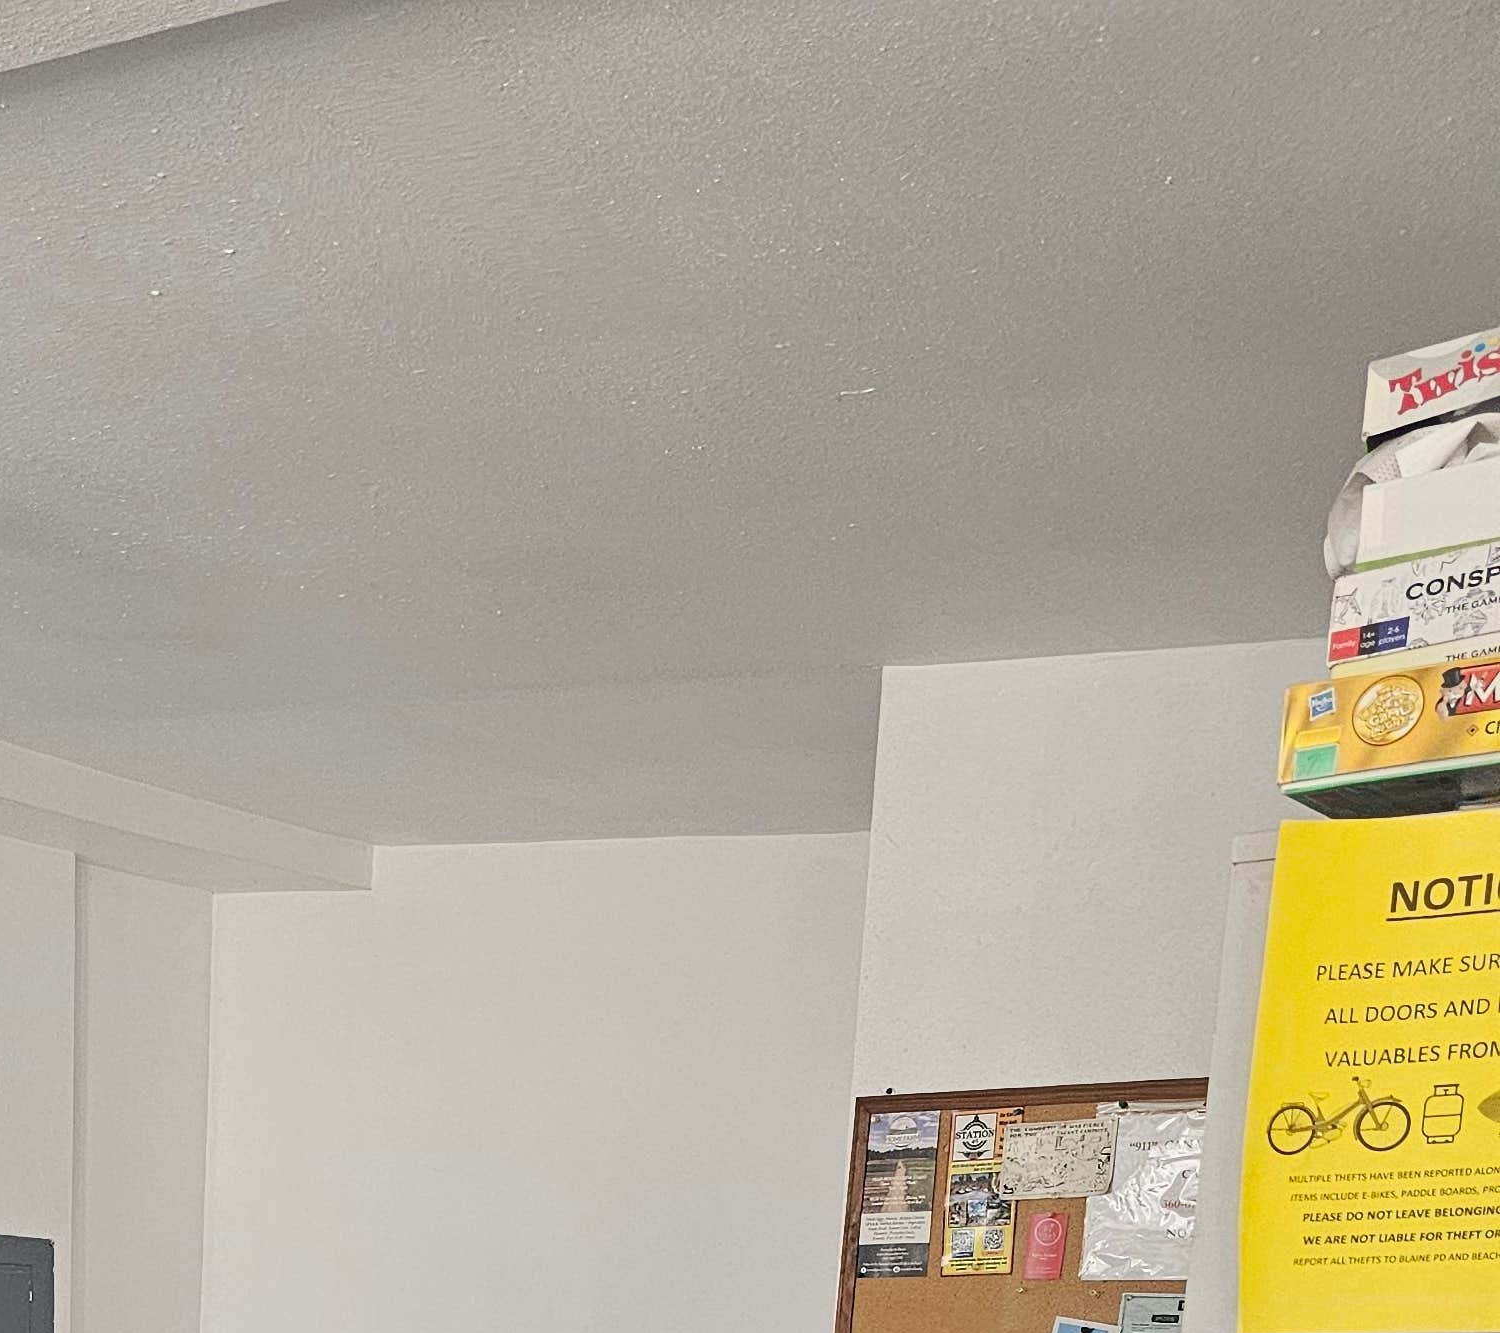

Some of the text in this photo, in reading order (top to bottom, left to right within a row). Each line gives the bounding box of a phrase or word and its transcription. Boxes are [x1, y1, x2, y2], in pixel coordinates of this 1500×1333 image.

[1405, 566, 1500, 600] CONSP
[1446, 596, 1500, 614] THE GAM
[1446, 645, 1500, 664] THE GAM
[1390, 873, 1500, 912] NOTI
[1317, 953, 1500, 981] PLEASE MAKE SUR
[1324, 998, 1490, 1024] ALL DOORS AND
[1325, 1045, 1441, 1067] VALUABLES
[955, 1129, 995, 1140] STATION
[1288, 1174, 1331, 1183] MULTIPLE
[1334, 1173, 1367, 1182] THEFTS
[1370, 1172, 1394, 1180] HAVE
[1397, 1170, 1421, 1179] BEEN
[1424, 1168, 1472, 1177] REPORTED
[1290, 1193, 1318, 1202] ITEMS
[1320, 1192, 1359, 1200] INCLUDE
[1401, 1188, 1437, 1197] PADDLE
[1303, 1212, 1342, 1222] PLEASE
[1346, 1211, 1363, 1220] DO
[1367, 1210, 1392, 1220] NOT
[1395, 1208, 1431, 1219] LEAVE
[1303, 1236, 1321, 1245] WE
[1324, 1235, 1347, 1244] ARE
[1350, 1234, 1375, 1243] NOT
[1379, 1233, 1416, 1243] LIABLE
[1419, 1232, 1443, 1241] FOR
[1446, 1230, 1482, 1240] THEFT
[1293, 1257, 1328, 1266] REPORT
[1330, 1256, 1345, 1265] ALL
[1348, 1256, 1381, 1265] THEFTS
[1384, 1255, 1396, 1263] TO
[1399, 1253, 1430, 1263] BLAINE
[1433, 1253, 1446, 1262] PD
[1449, 1252, 1469, 1261] AND
